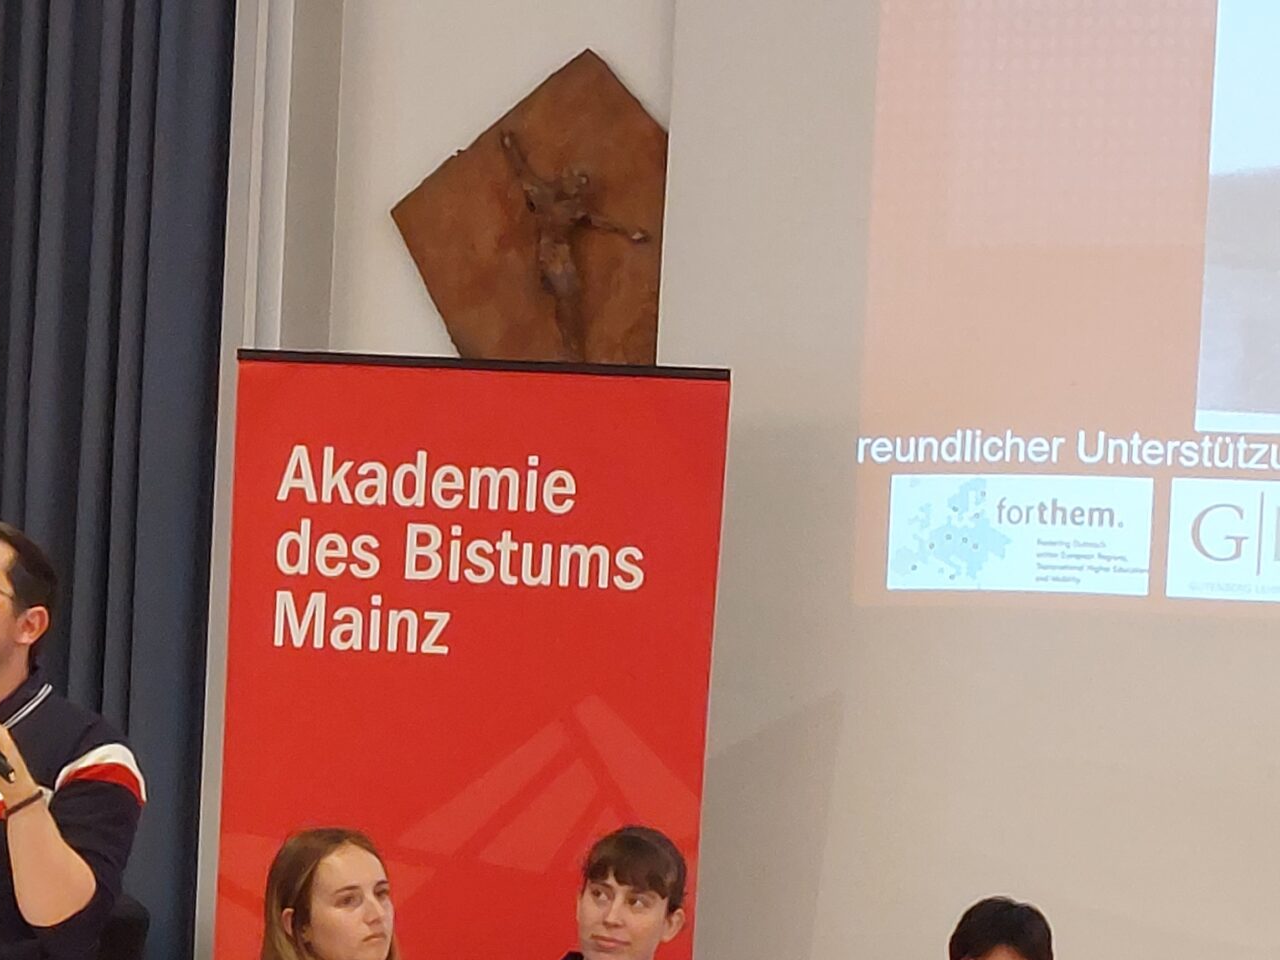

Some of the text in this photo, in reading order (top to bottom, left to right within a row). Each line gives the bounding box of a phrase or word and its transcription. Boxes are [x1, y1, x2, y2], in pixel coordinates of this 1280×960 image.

[276, 444, 578, 515] Akademie
[857, 429, 1066, 465] reundlicher
[997, 497, 1125, 529] forthem.
[275, 518, 646, 591] des Bistums
[273, 590, 451, 655] Mainz
